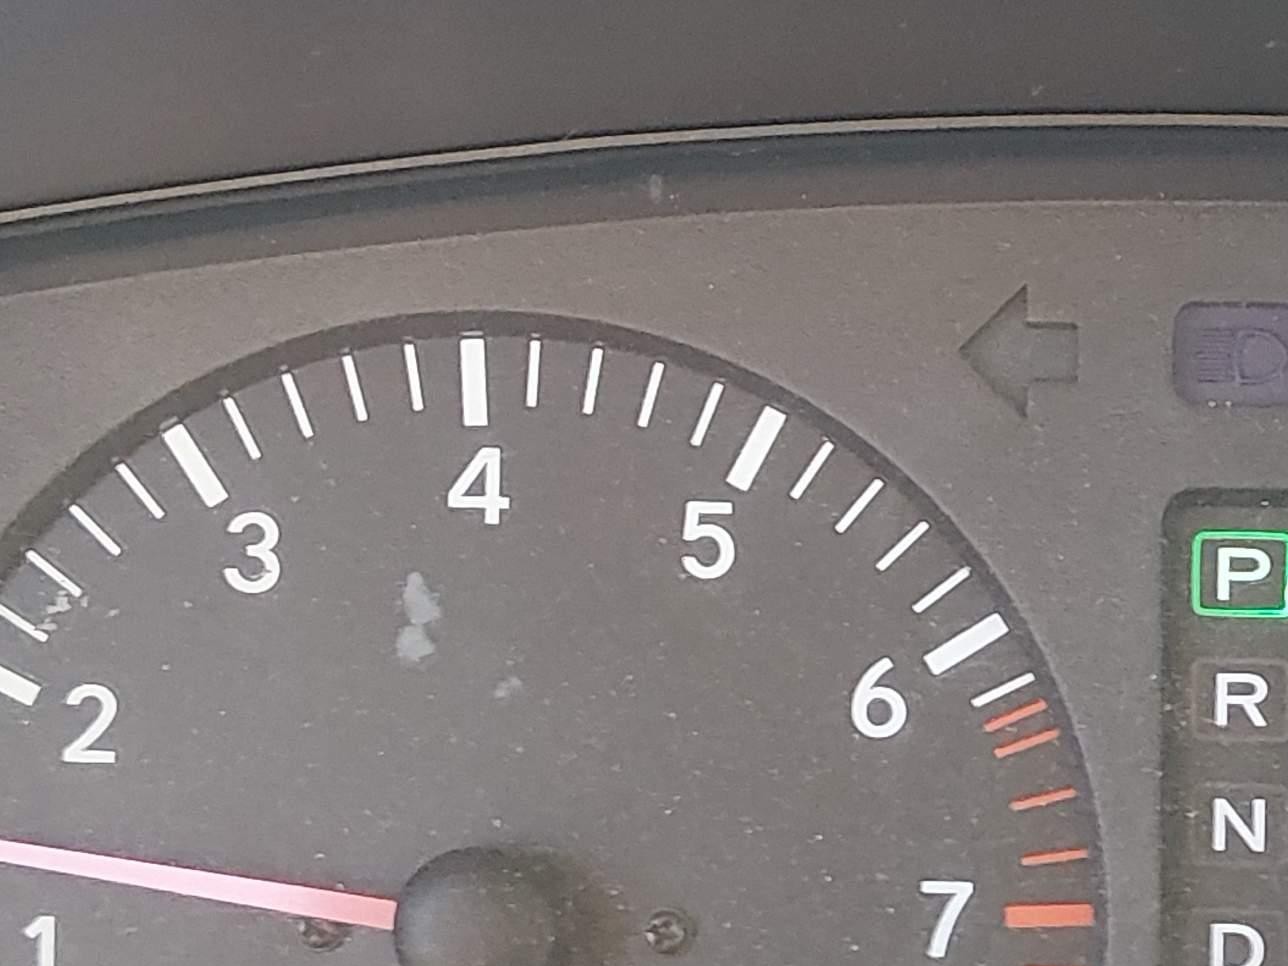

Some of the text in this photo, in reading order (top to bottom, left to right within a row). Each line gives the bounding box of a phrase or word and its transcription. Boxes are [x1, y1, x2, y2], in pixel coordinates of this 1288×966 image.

[448, 448, 509, 524] 4
[224, 512, 280, 593] 3
[682, 501, 734, 579] 5
[1215, 547, 1271, 601] P
[62, 684, 117, 763] 2
[852, 658, 906, 737] 6
[1215, 673, 1267, 726] R
[1213, 799, 1265, 851] N
[921, 881, 973, 957] 7
